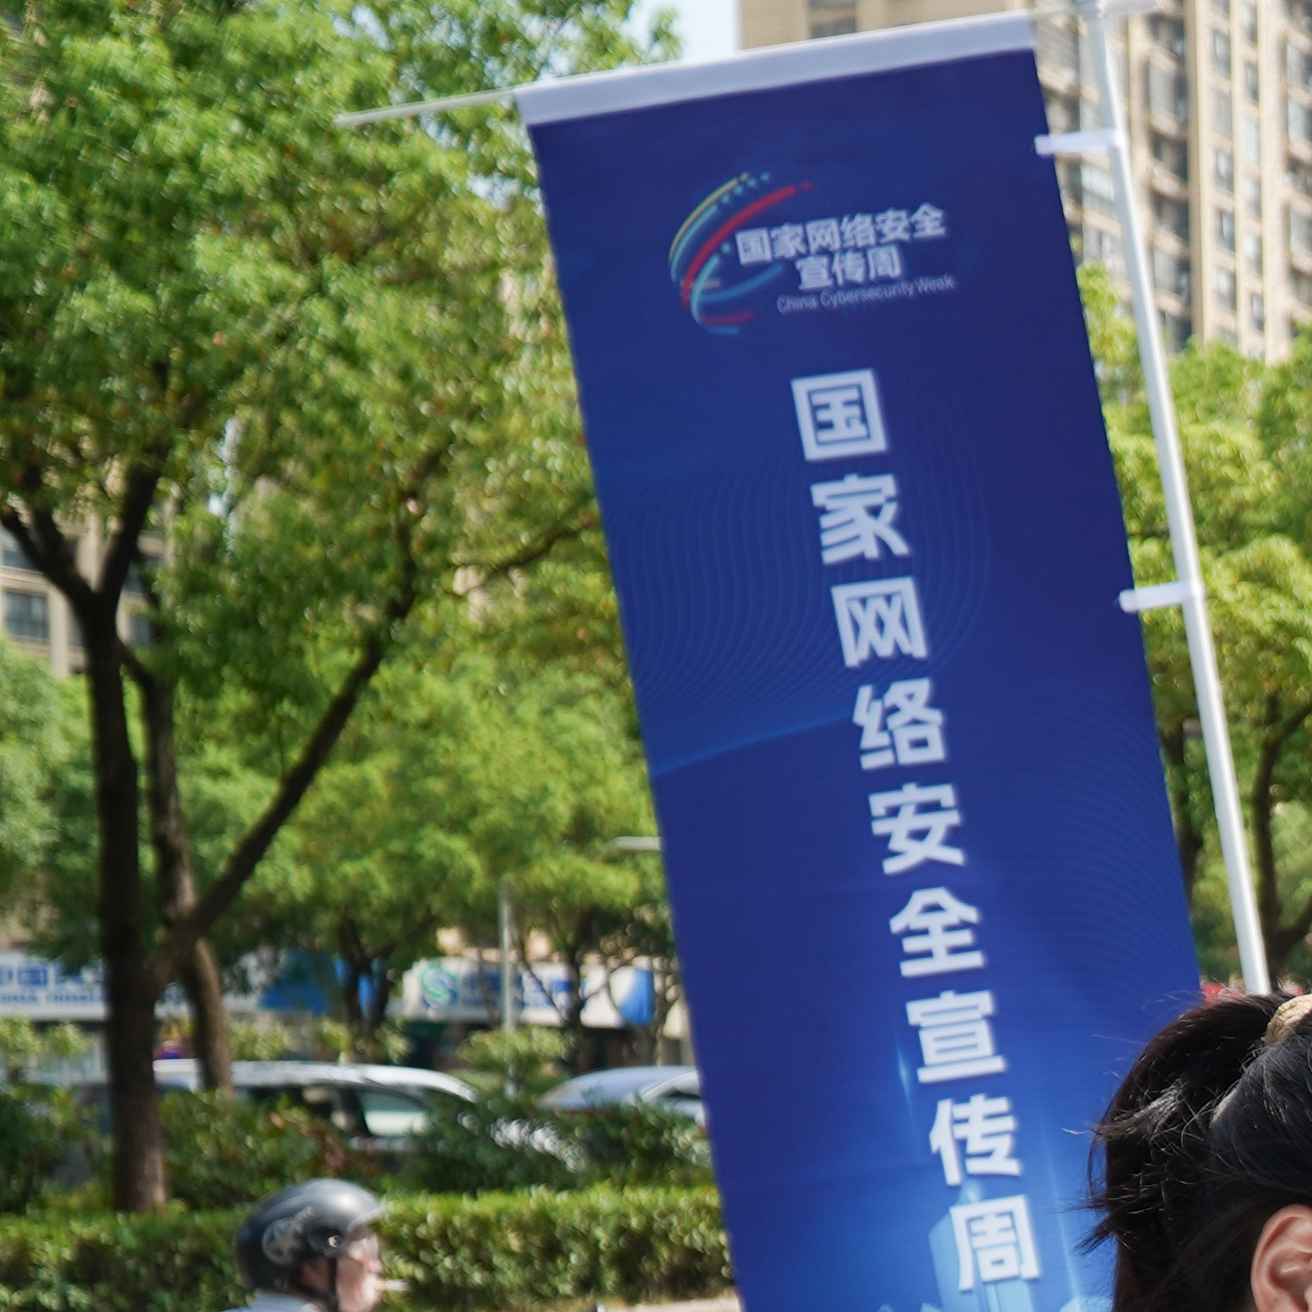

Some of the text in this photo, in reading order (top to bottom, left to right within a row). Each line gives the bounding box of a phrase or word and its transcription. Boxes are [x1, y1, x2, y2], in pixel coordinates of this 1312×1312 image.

[735, 203, 947, 265] 国家网络安全
[796, 247, 901, 291] 宣传周
[898, 274, 956, 298] Week
[790, 368, 1041, 1293] 国家网络安全宣传周
